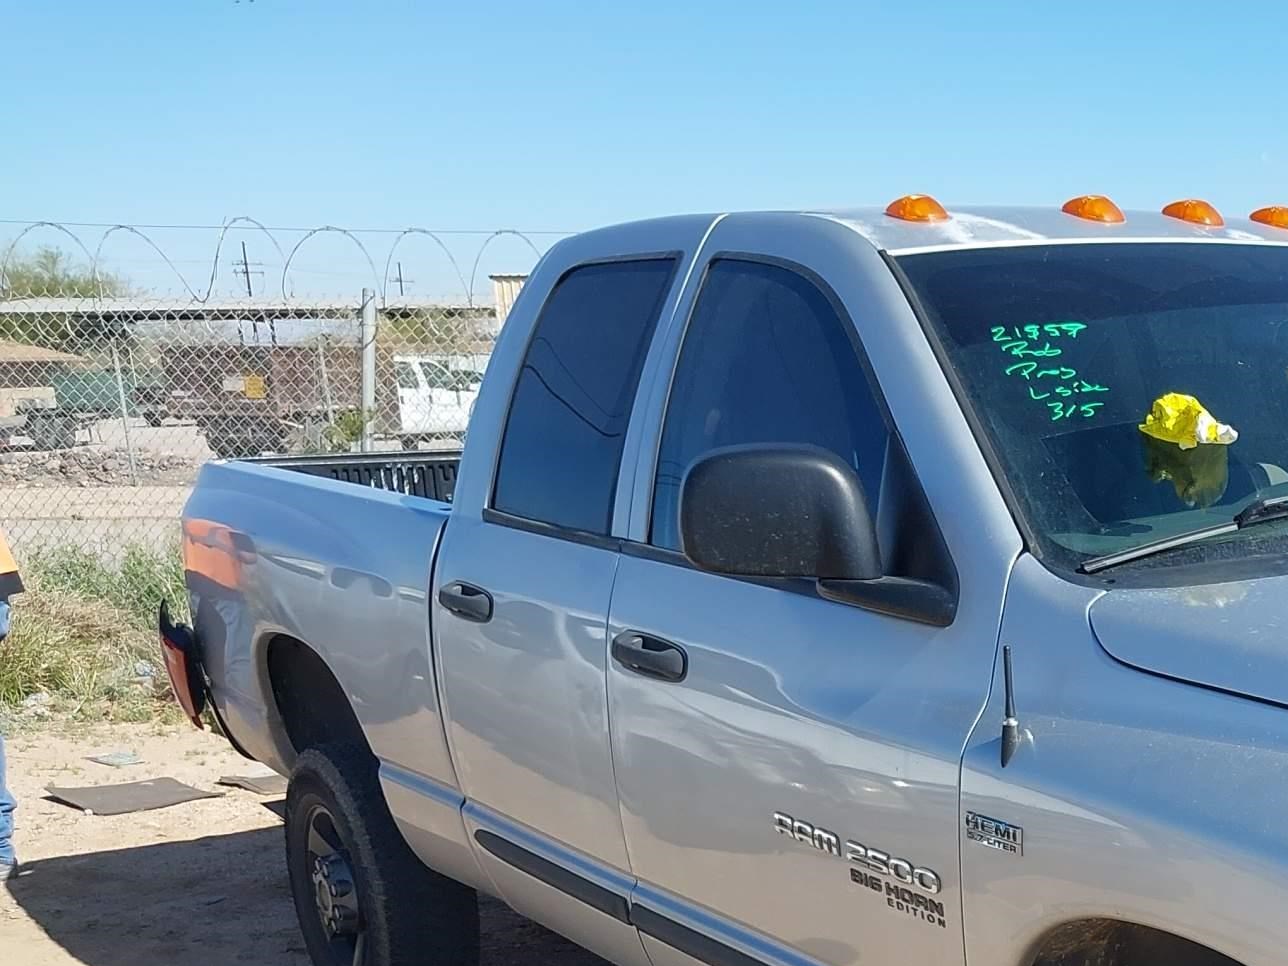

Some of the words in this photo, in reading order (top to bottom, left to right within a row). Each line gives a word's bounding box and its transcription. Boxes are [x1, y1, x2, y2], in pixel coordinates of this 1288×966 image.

[965, 812, 1018, 842] HEMI
[773, 810, 842, 857] RAM
[846, 839, 942, 894] 2500
[850, 867, 883, 892] BIG
[884, 881, 945, 917] HORN
[886, 896, 946, 928] EDITION
